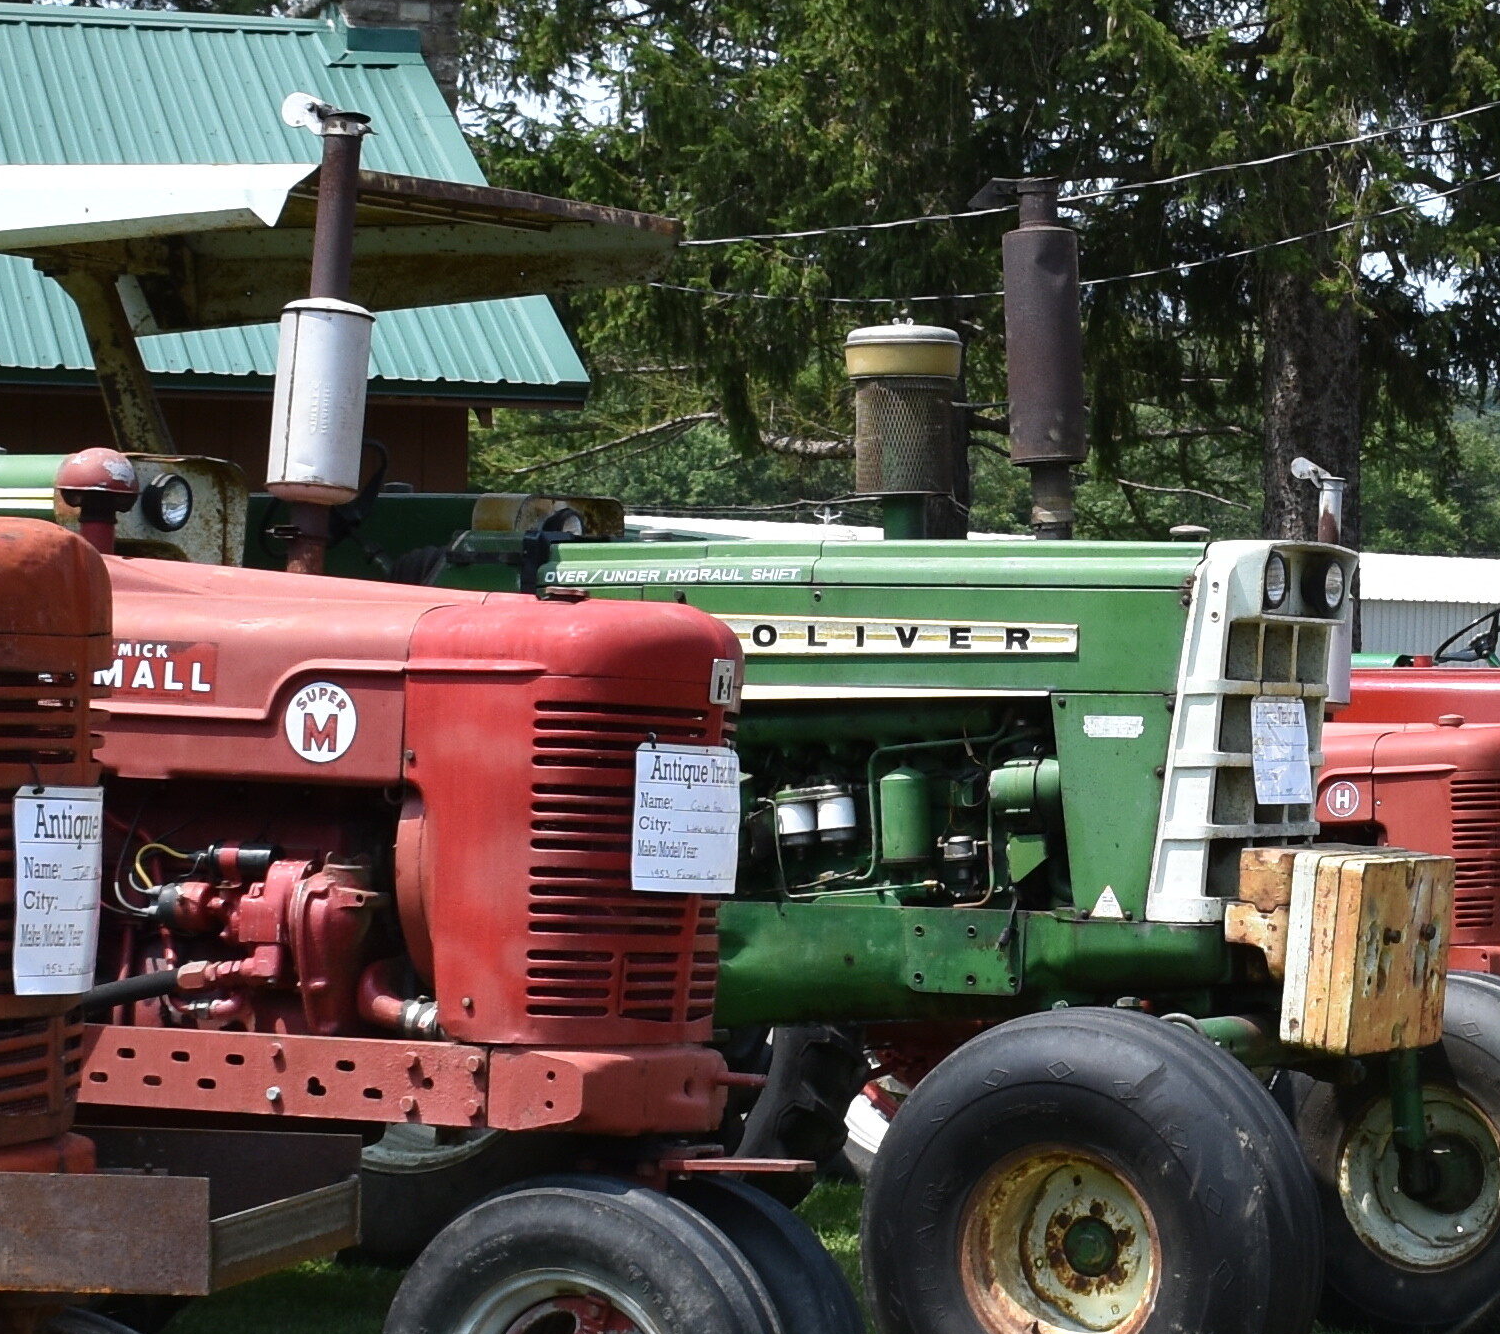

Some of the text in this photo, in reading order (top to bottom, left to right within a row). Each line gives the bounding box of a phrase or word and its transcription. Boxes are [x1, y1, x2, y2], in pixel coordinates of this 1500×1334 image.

[665, 569, 744, 582] HYDRAUL
[751, 568, 800, 580] SHIFT
[752, 624, 1031, 651] OLIVER
[117, 643, 168, 659] MICK
[295, 687, 348, 712] SUPER
[301, 713, 338, 752] M
[650, 755, 708, 789] Antique
[640, 792, 673, 810] Name:
[1335, 789, 1350, 809] H
[34, 803, 100, 850] Antique
[638, 815, 671, 834] City:
[23, 856, 62, 880] Name:
[23, 890, 59, 916] City:
